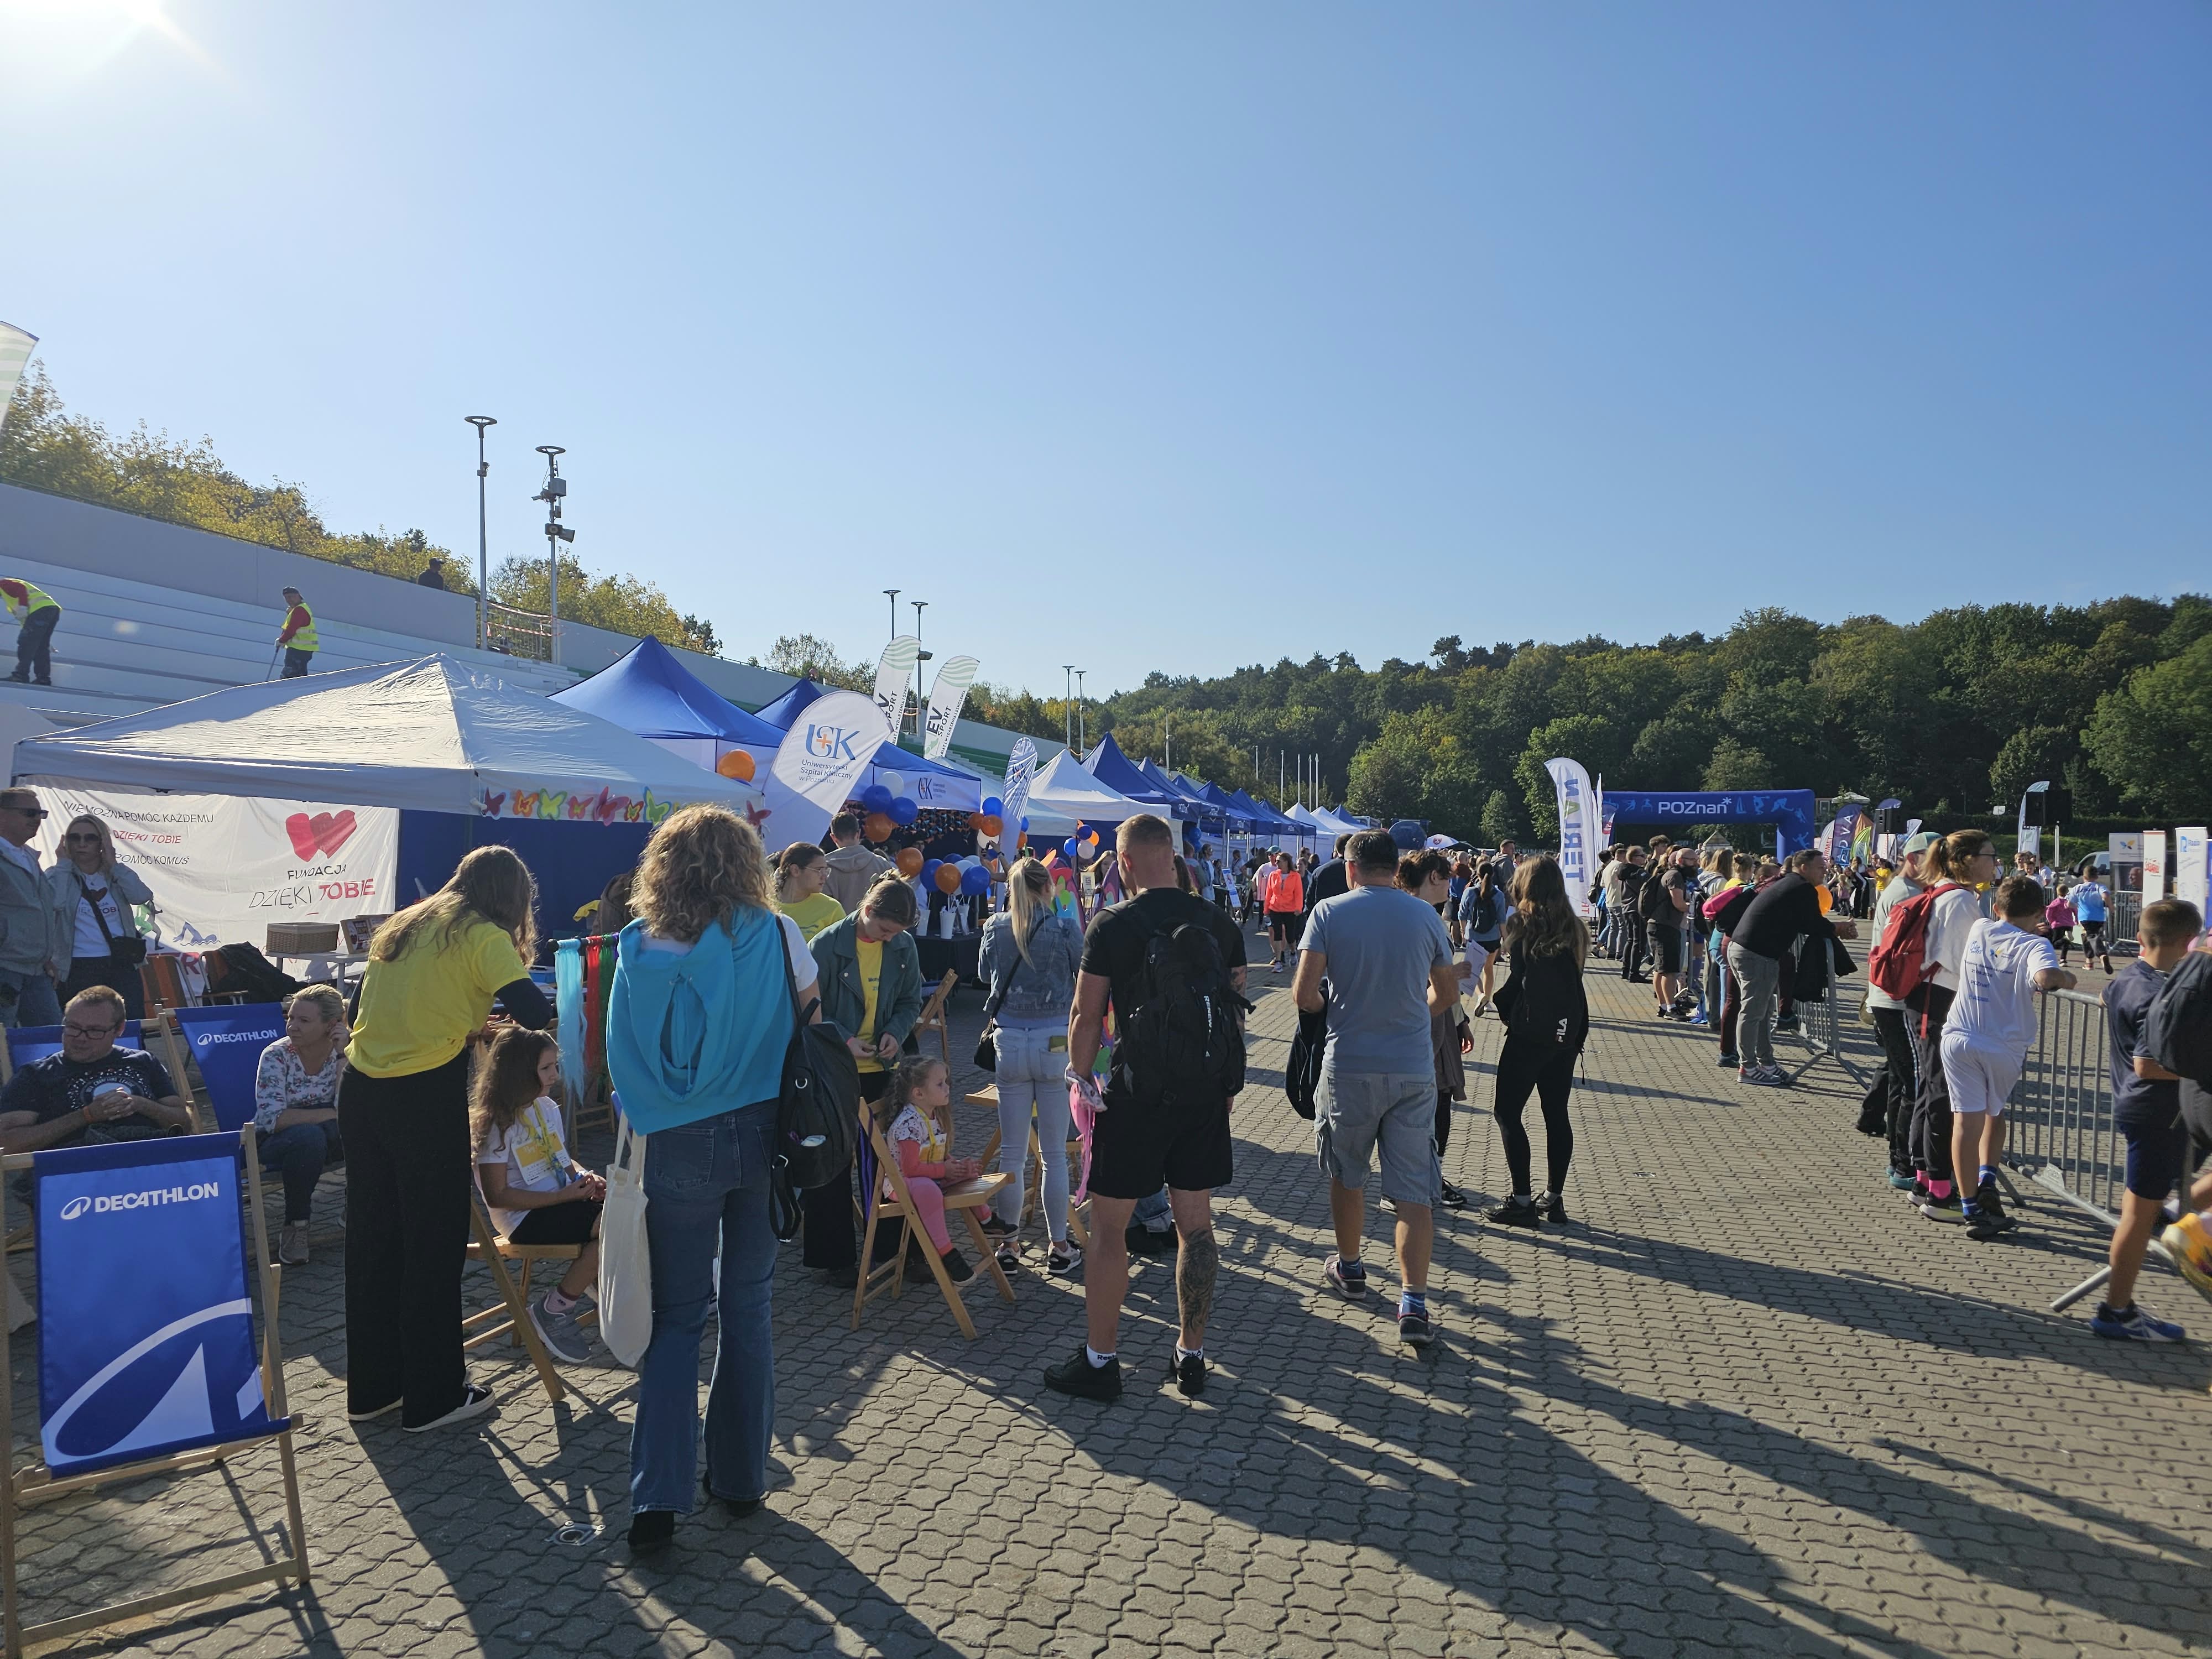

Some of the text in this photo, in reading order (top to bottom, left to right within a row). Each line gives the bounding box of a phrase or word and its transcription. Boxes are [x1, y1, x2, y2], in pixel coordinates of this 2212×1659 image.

[885, 690, 898, 719] PORT
[895, 698, 905, 731] WYDARZENIA
[902, 673, 912, 697] SZKOLENIA
[926, 706, 943, 735] EV
[937, 706, 952, 737] SPORT
[945, 717, 956, 743] WYDARZENIA
[955, 690, 966, 714] SZKOLENIA
[800, 767, 853, 780] Szpital Kliniczny
[802, 759, 848, 770] Uniwersytecki
[806, 776, 835, 784] Poznaniu
[64, 801, 214, 823] NIE MOŻNA POMÓC KAŻDEMU
[113, 830, 181, 844] DZIĘKI TOBIE
[114, 853, 190, 865] POMÓC KOMUŚ
[287, 864, 347, 880] FUNDACJA
[249, 878, 375, 909] DZIĘKI TOBIE
[213, 1029, 278, 1044] DECATHLON
[1556, 1018, 1568, 1042] FILA
[95, 1182, 219, 1213] DECATHLON
